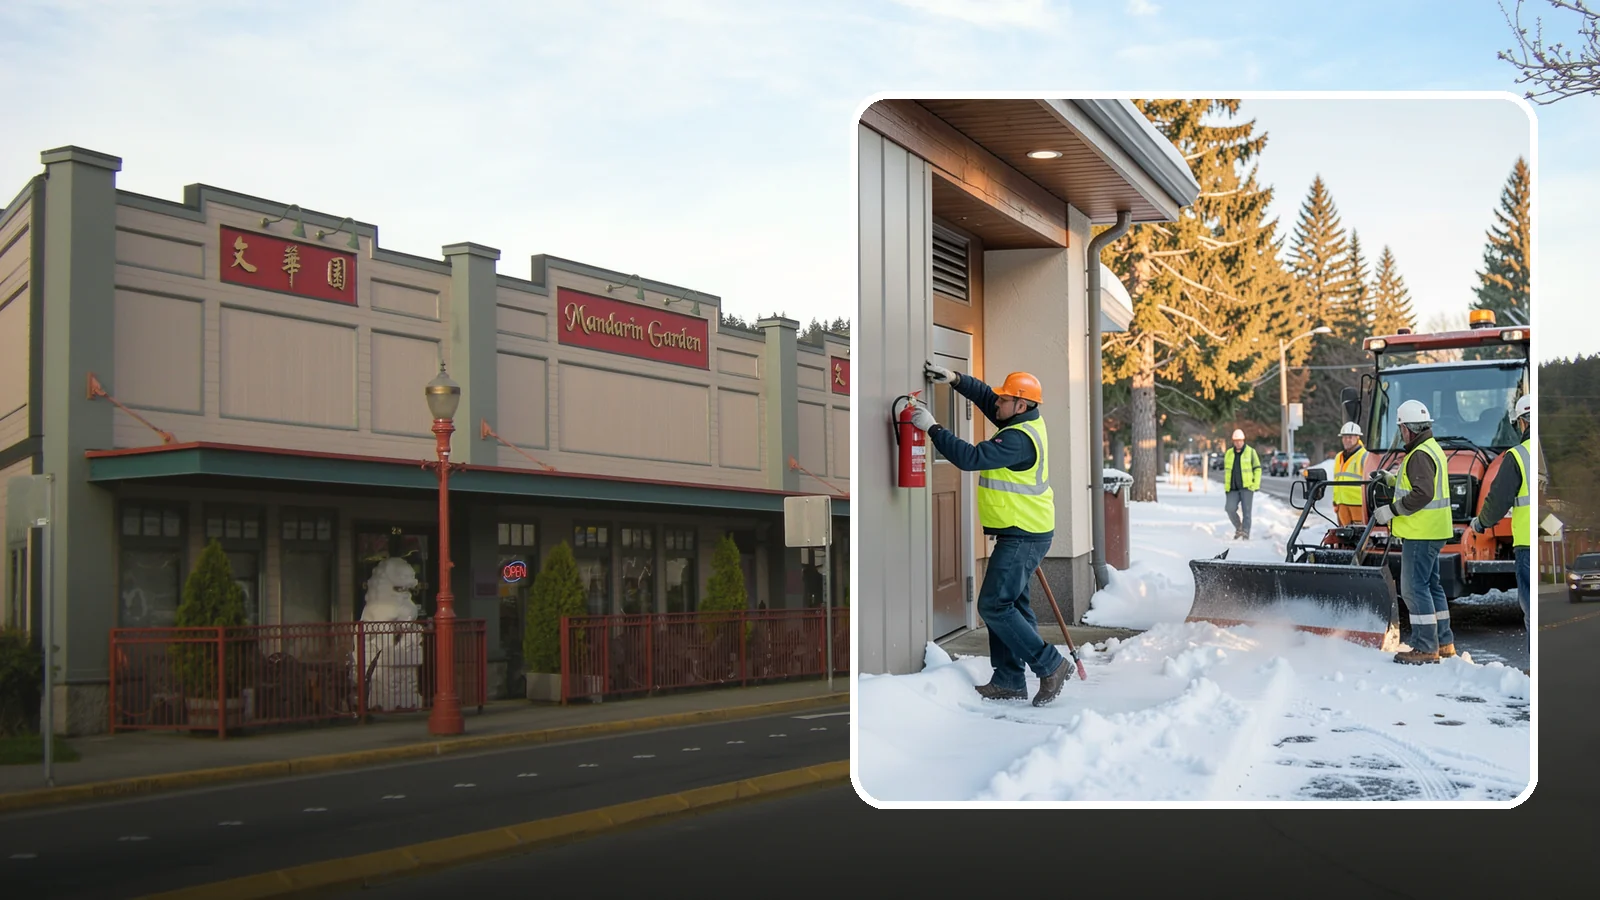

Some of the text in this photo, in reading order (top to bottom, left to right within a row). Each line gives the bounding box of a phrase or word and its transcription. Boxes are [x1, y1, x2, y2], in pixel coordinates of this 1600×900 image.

[231, 236, 346, 291] 文華園
[565, 302, 701, 352] Mandarin Garden
[503, 565, 526, 578] OPEN
